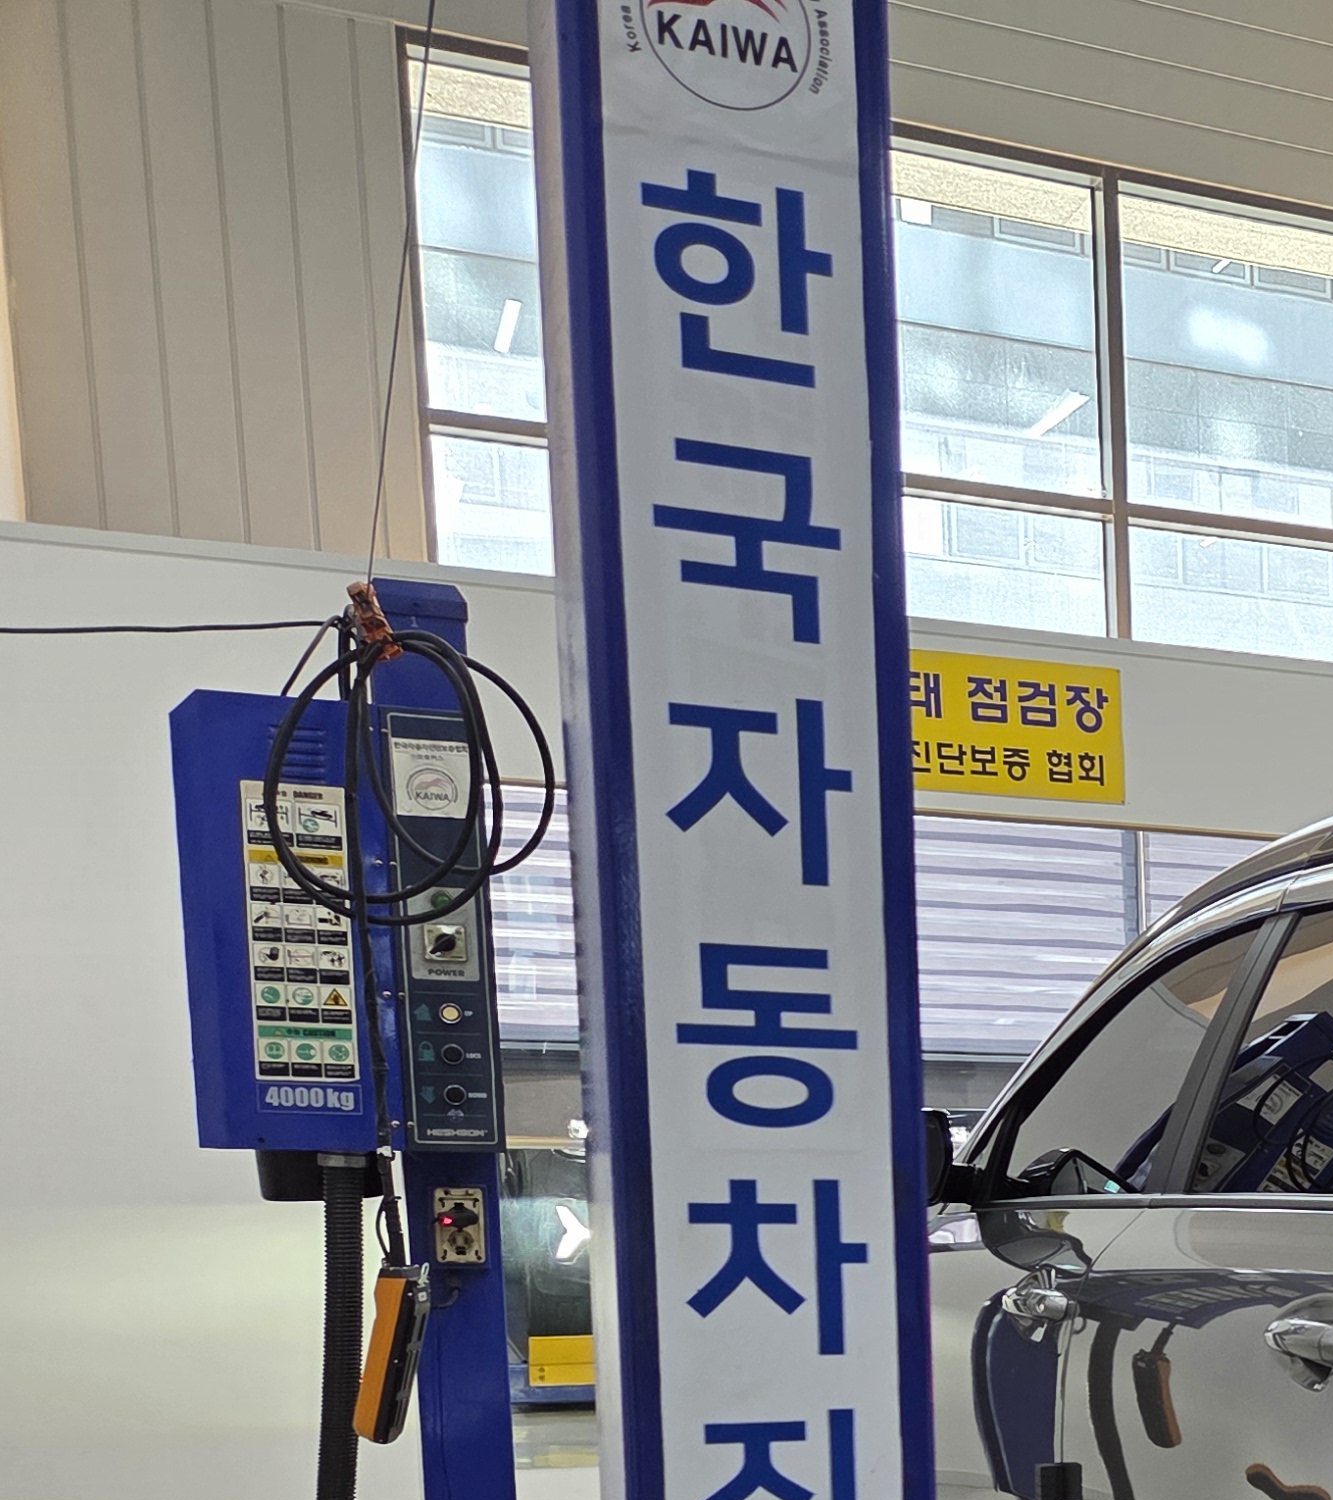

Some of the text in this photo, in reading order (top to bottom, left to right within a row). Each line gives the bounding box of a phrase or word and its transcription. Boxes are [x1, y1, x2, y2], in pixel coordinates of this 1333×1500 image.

[656, 9, 799, 74] KAIWA
[966, 675, 1108, 734] 점검장
[1046, 749, 1105, 787] 협회
[415, 791, 450, 802] KAIWA
[428, 968, 465, 977] POWER
